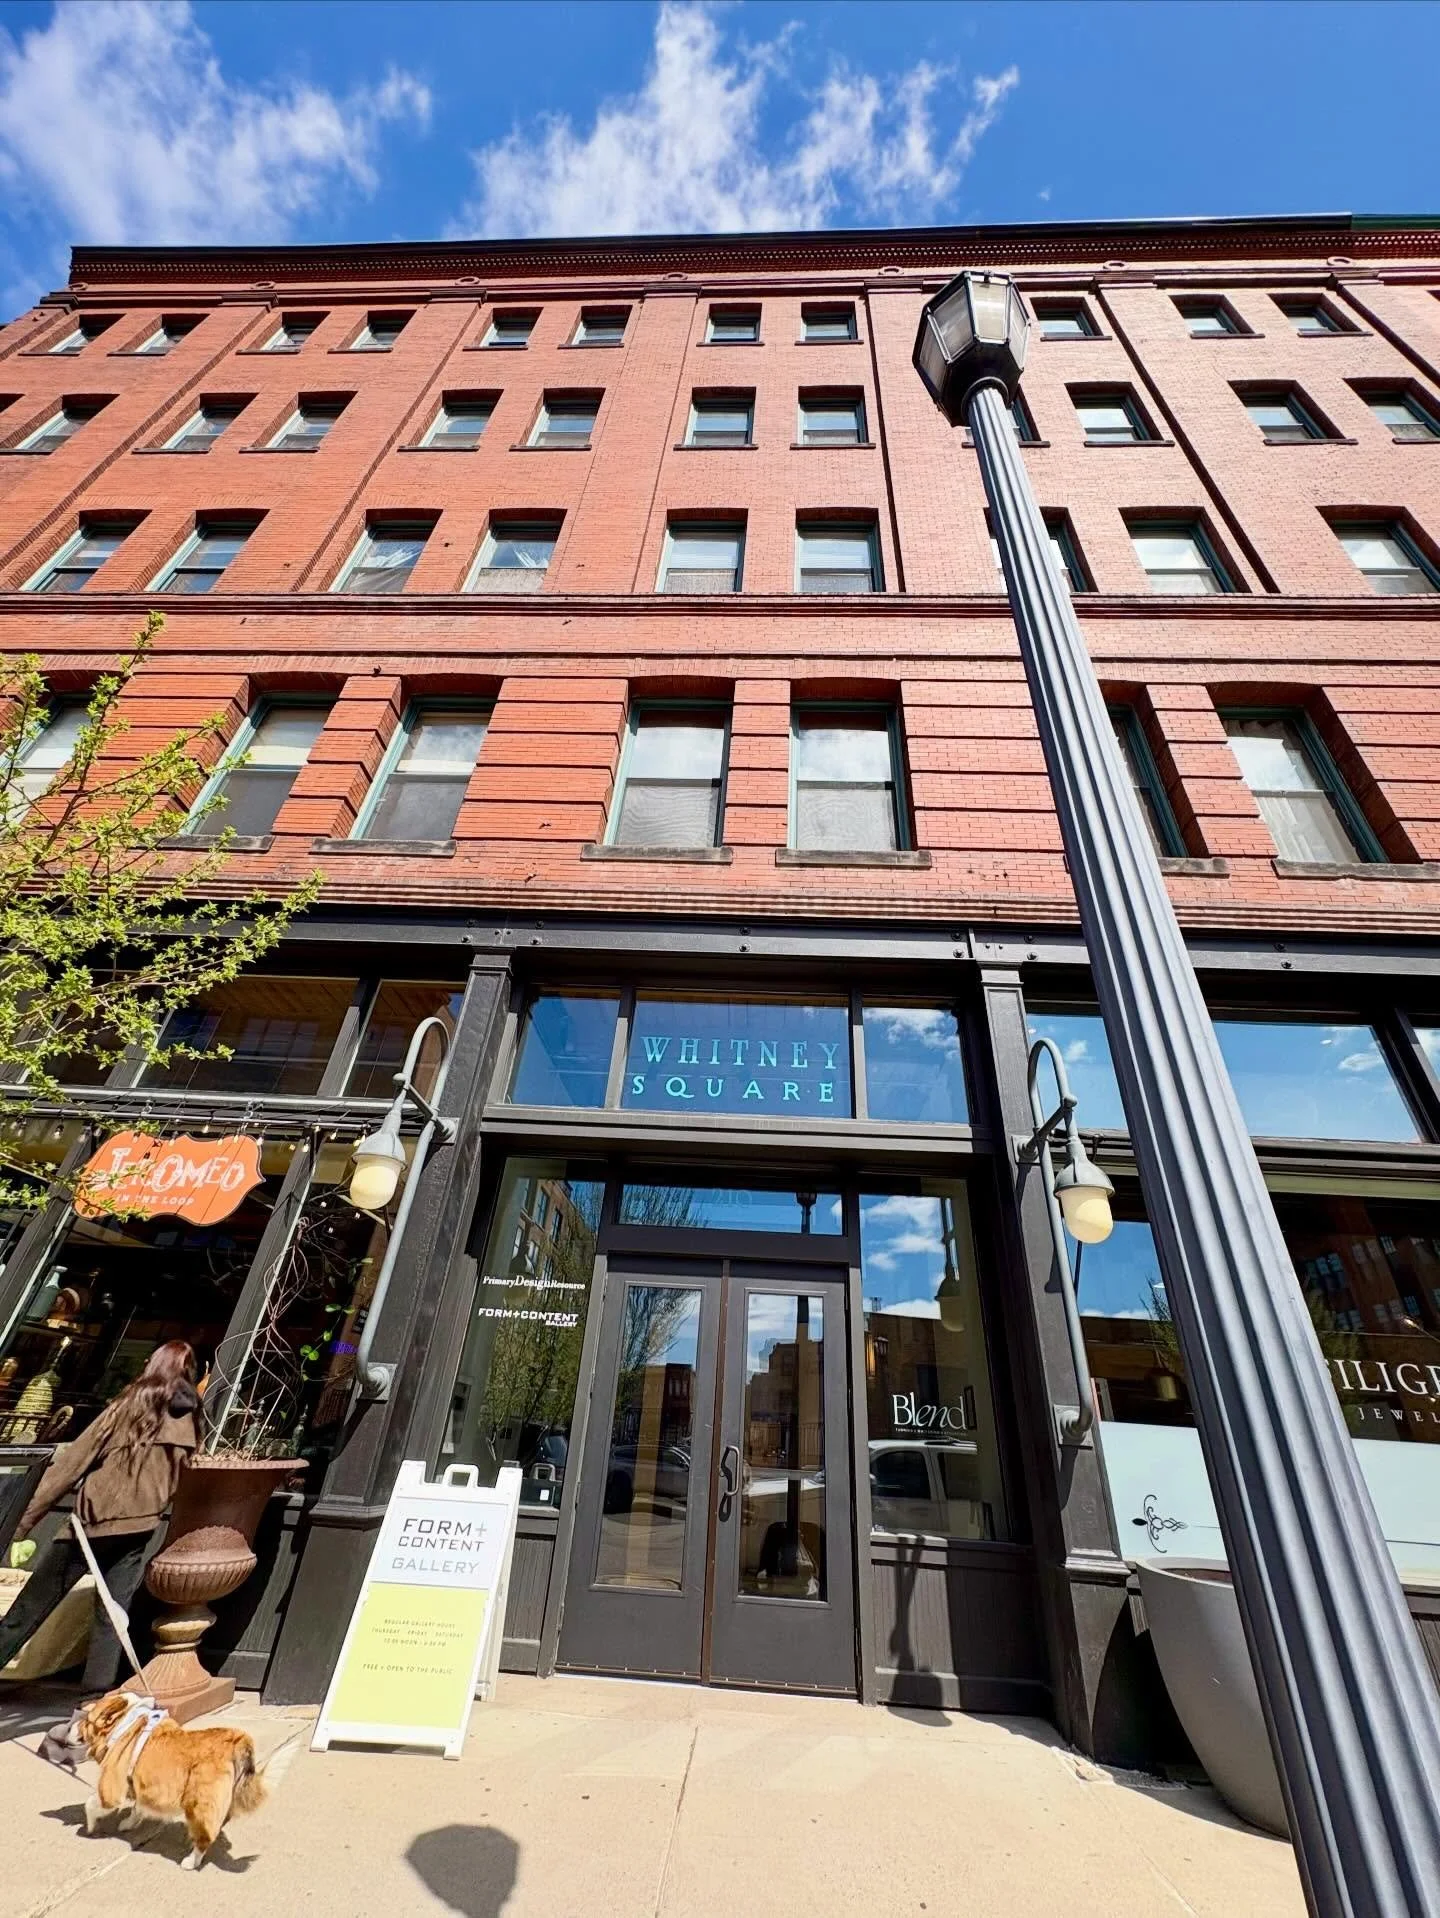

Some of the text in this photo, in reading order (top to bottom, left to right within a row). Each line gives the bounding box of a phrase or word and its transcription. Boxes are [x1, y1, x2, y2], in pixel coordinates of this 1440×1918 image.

[641, 1037, 839, 1069] WHITNEY
[632, 1075, 833, 1102] SQUARE
[161, 1196, 195, 1206] LOOP
[892, 1391, 967, 1430] Blend
[398, 1536, 484, 1552] CONTENT
[392, 1557, 479, 1574] GALLERY
[386, 1664, 404, 1672] OPEN
[430, 1667, 453, 1675] PUBLIC
